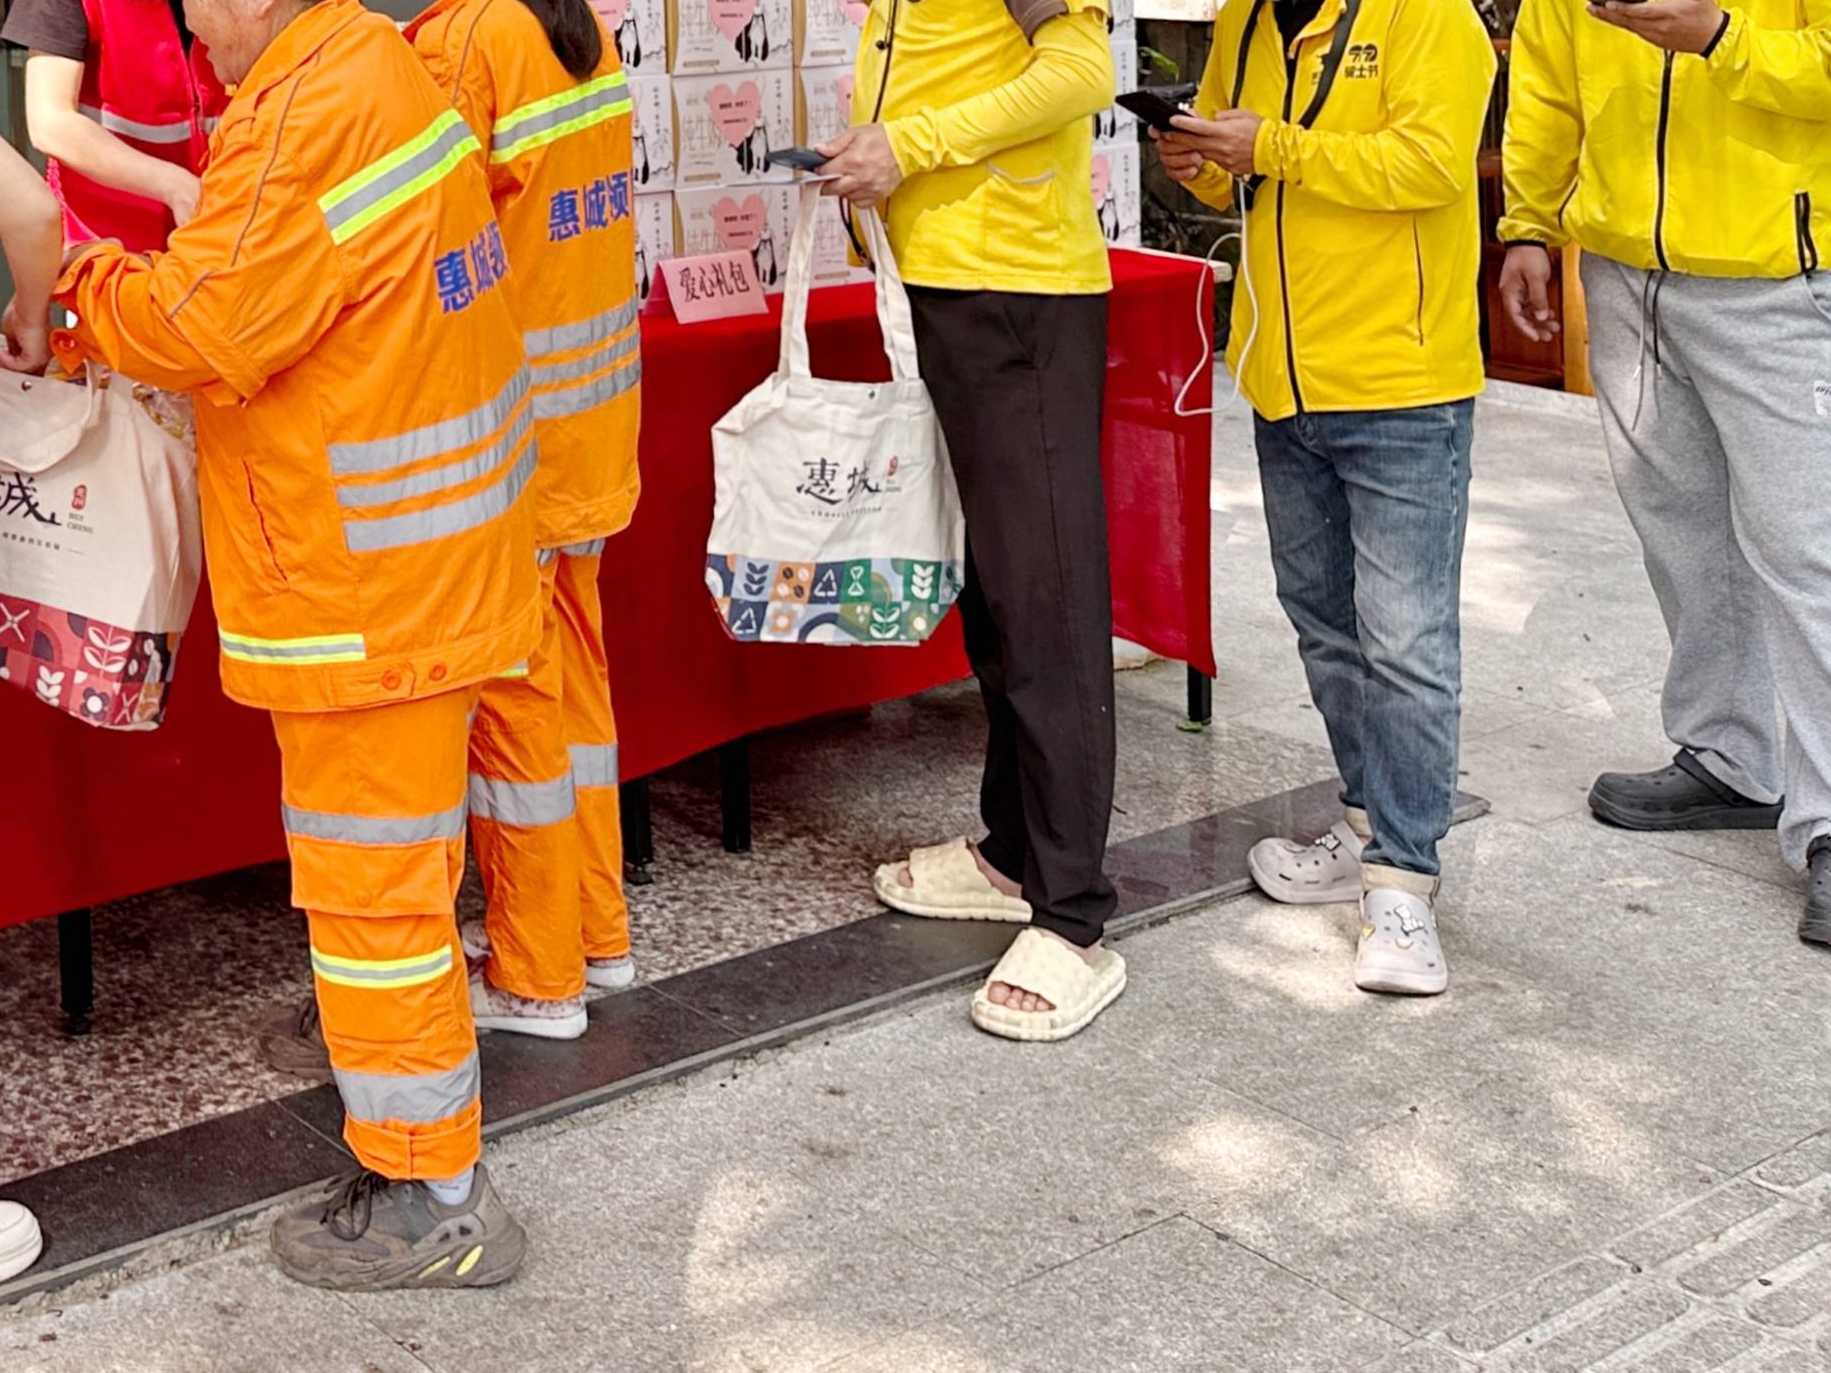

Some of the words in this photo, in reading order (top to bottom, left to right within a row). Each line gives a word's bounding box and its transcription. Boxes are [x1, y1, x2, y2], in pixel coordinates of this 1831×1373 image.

[678, 260, 751, 303] 爱心礼包
[795, 456, 883, 506] 惠城
